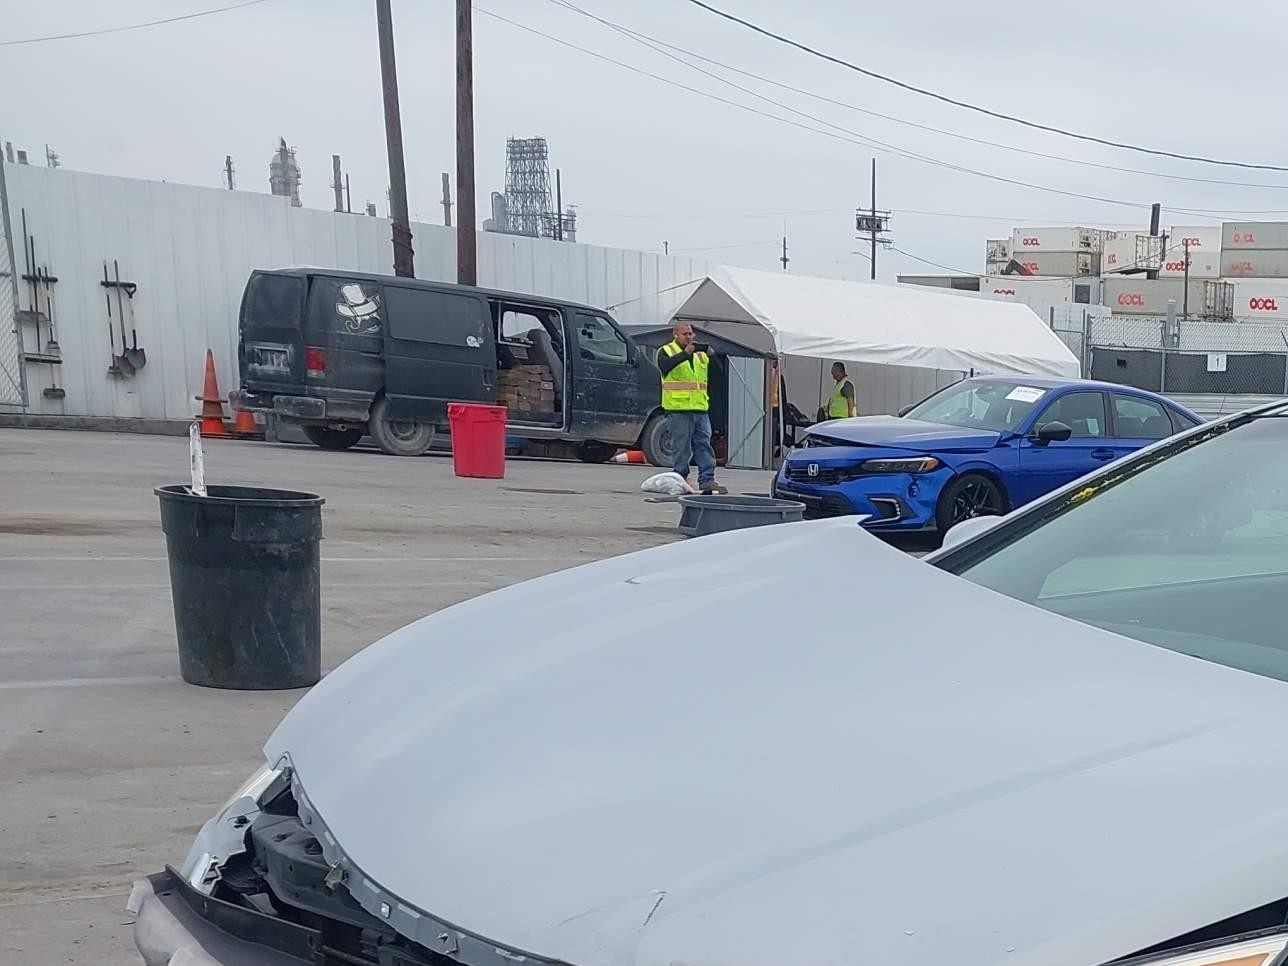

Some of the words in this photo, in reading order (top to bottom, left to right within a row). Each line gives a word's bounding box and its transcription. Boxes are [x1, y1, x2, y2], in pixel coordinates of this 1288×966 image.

[1022, 238, 1041, 246] OOCL
[1233, 233, 1255, 243] OCL
[1118, 294, 1145, 306] OOCL
[1249, 297, 1278, 310] OOCL
